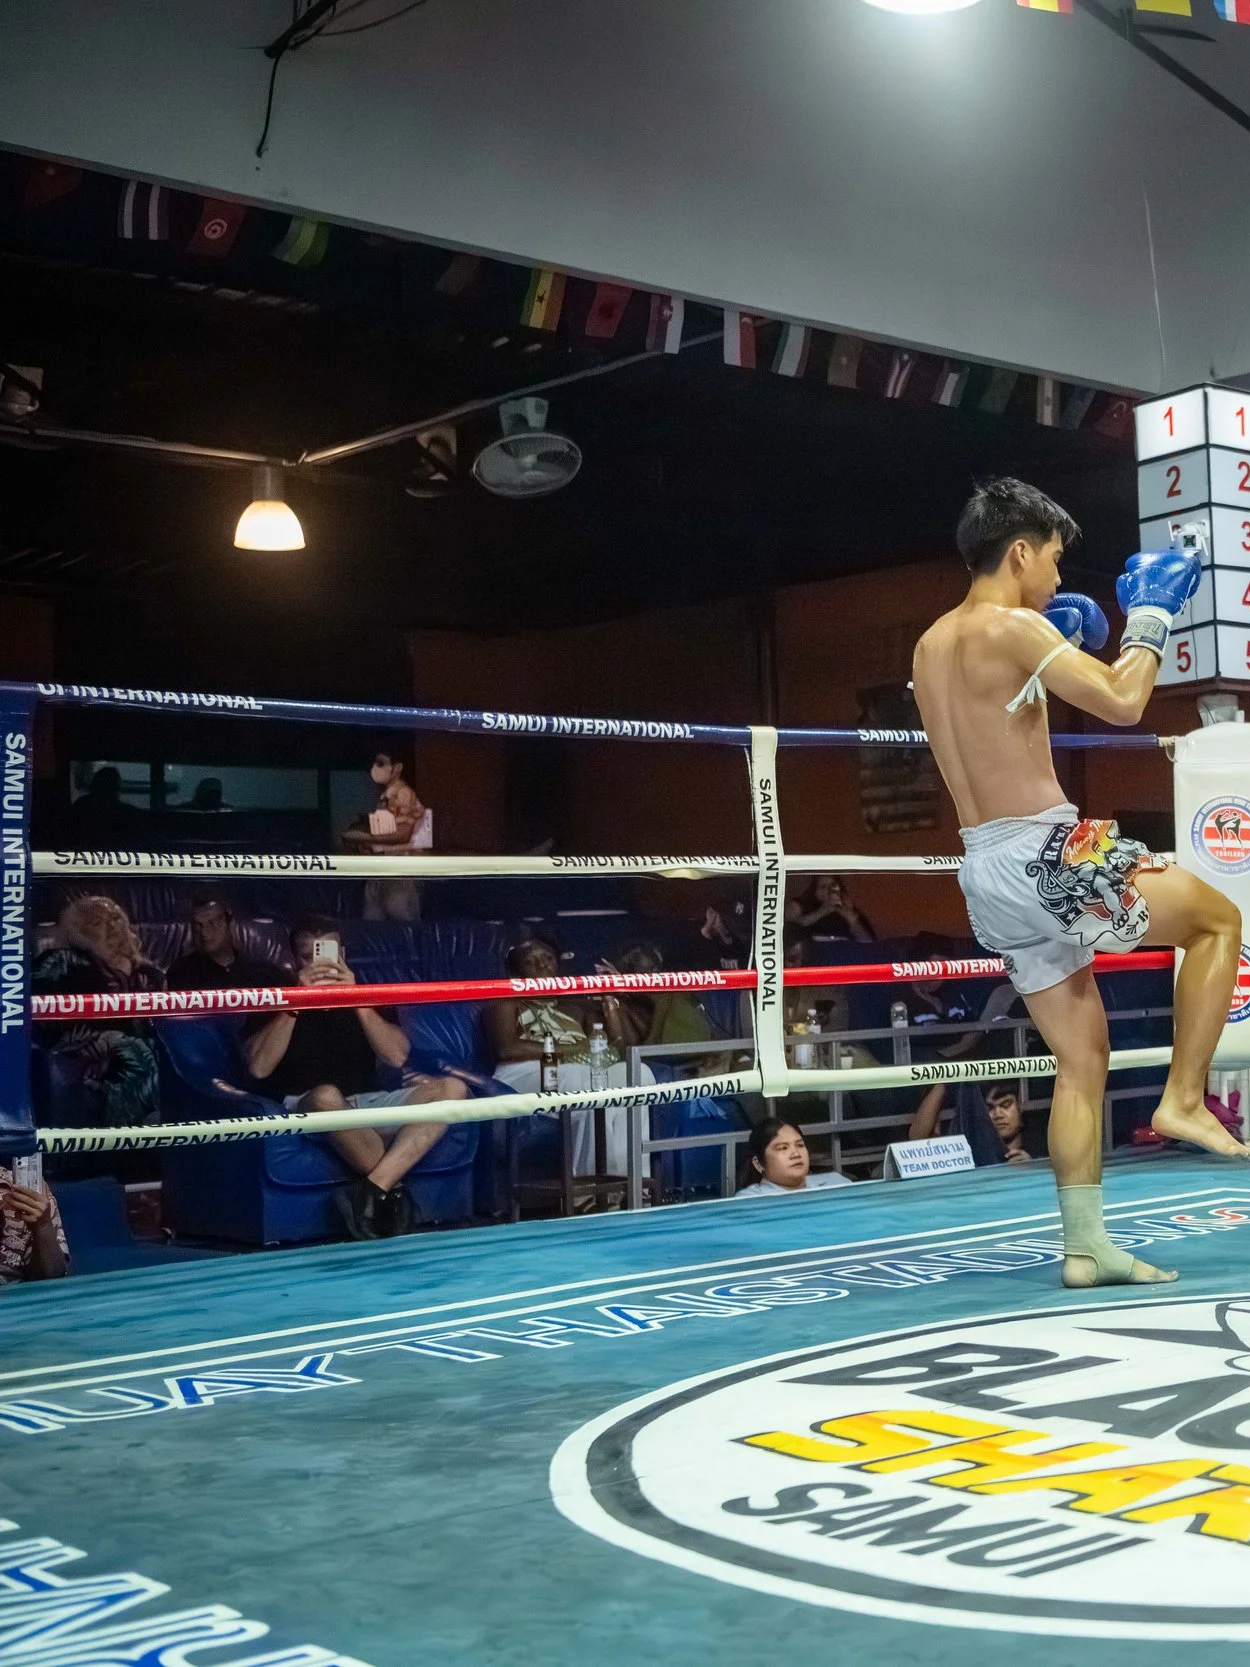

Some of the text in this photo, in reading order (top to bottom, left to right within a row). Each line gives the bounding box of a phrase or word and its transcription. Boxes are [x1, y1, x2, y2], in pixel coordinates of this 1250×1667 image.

[1163, 406, 1174, 436] 1
[1235, 406, 1246, 436] 1
[1166, 465, 1181, 498] 2
[1176, 640, 1192, 673] 5
[481, 711, 695, 739] SAMUI INTERNATIONAL
[859, 729, 910, 743] SAMUI
[54, 852, 337, 872] SAMUI INTERNATIONAL
[1, 732, 26, 1034] SAMUI INTERNATIONAL
[760, 777, 779, 1011] SAMUI INTERNATIONAL
[512, 970, 726, 993] SAMUI INTERNATIONAL
[892, 961, 943, 977] SAMUI
[32, 987, 289, 1013] MUI INTERNATIONAL
[911, 1058, 1056, 1081] SAMUI INTERNATION
[603, 1079, 746, 1108] INTERNATIONAL
[36, 1133, 111, 1153] AMUI
[900, 1140, 965, 1160] แพทย์สนาม
[903, 1156, 972, 1174] TEAM DOCTOR
[722, 1482, 1154, 1579] SAMUI
